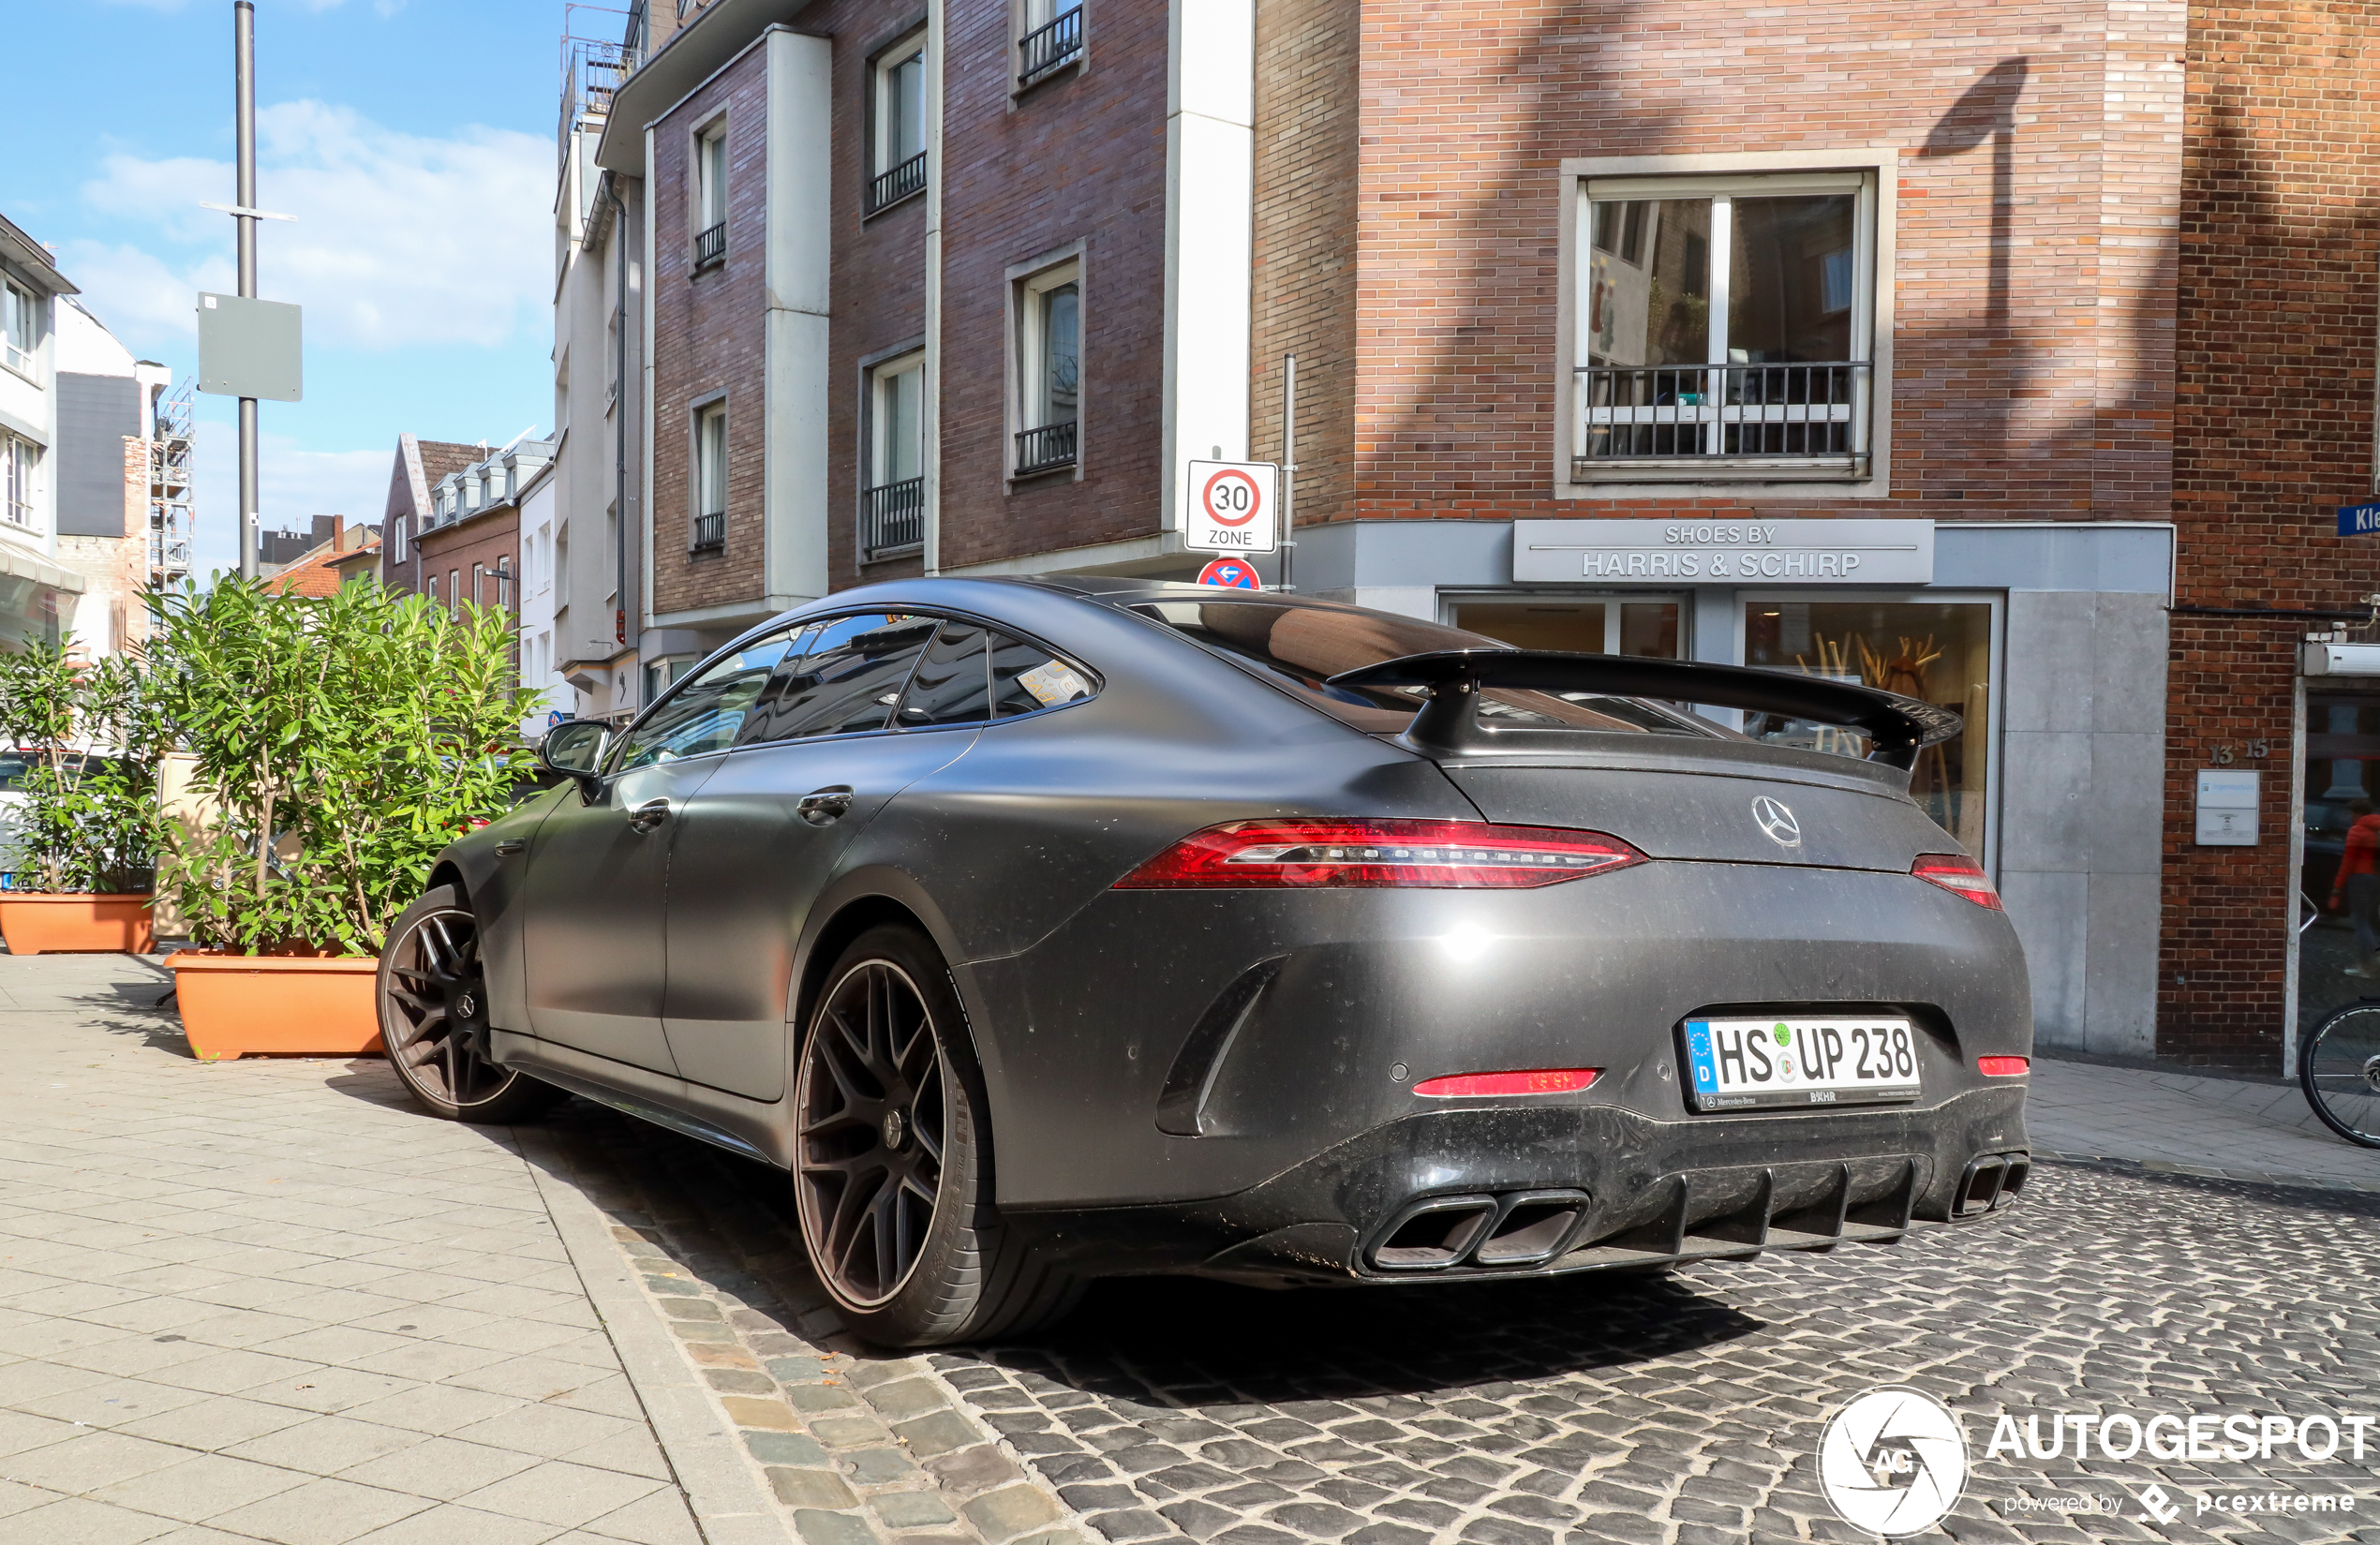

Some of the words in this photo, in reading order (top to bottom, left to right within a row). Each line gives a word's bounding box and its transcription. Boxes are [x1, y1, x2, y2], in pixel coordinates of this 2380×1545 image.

[1214, 484, 1248, 512] 30
[1209, 529, 1253, 545] ZONE
[1665, 526, 1741, 543] SHOES
[1748, 526, 1778, 543] BY
[1582, 552, 1700, 577] HARRIS
[1708, 552, 1732, 577] &
[1738, 552, 1861, 577] SCHIRP
[2209, 744, 2234, 765] 13
[2245, 738, 2269, 759] 15
[1717, 1030, 1773, 1084] HS
[1796, 1028, 1844, 1079] UP
[1852, 1028, 1913, 1079] 238
[1699, 1066, 1710, 1082] D
[1717, 1096, 1757, 1107] Mercedes-Benz
